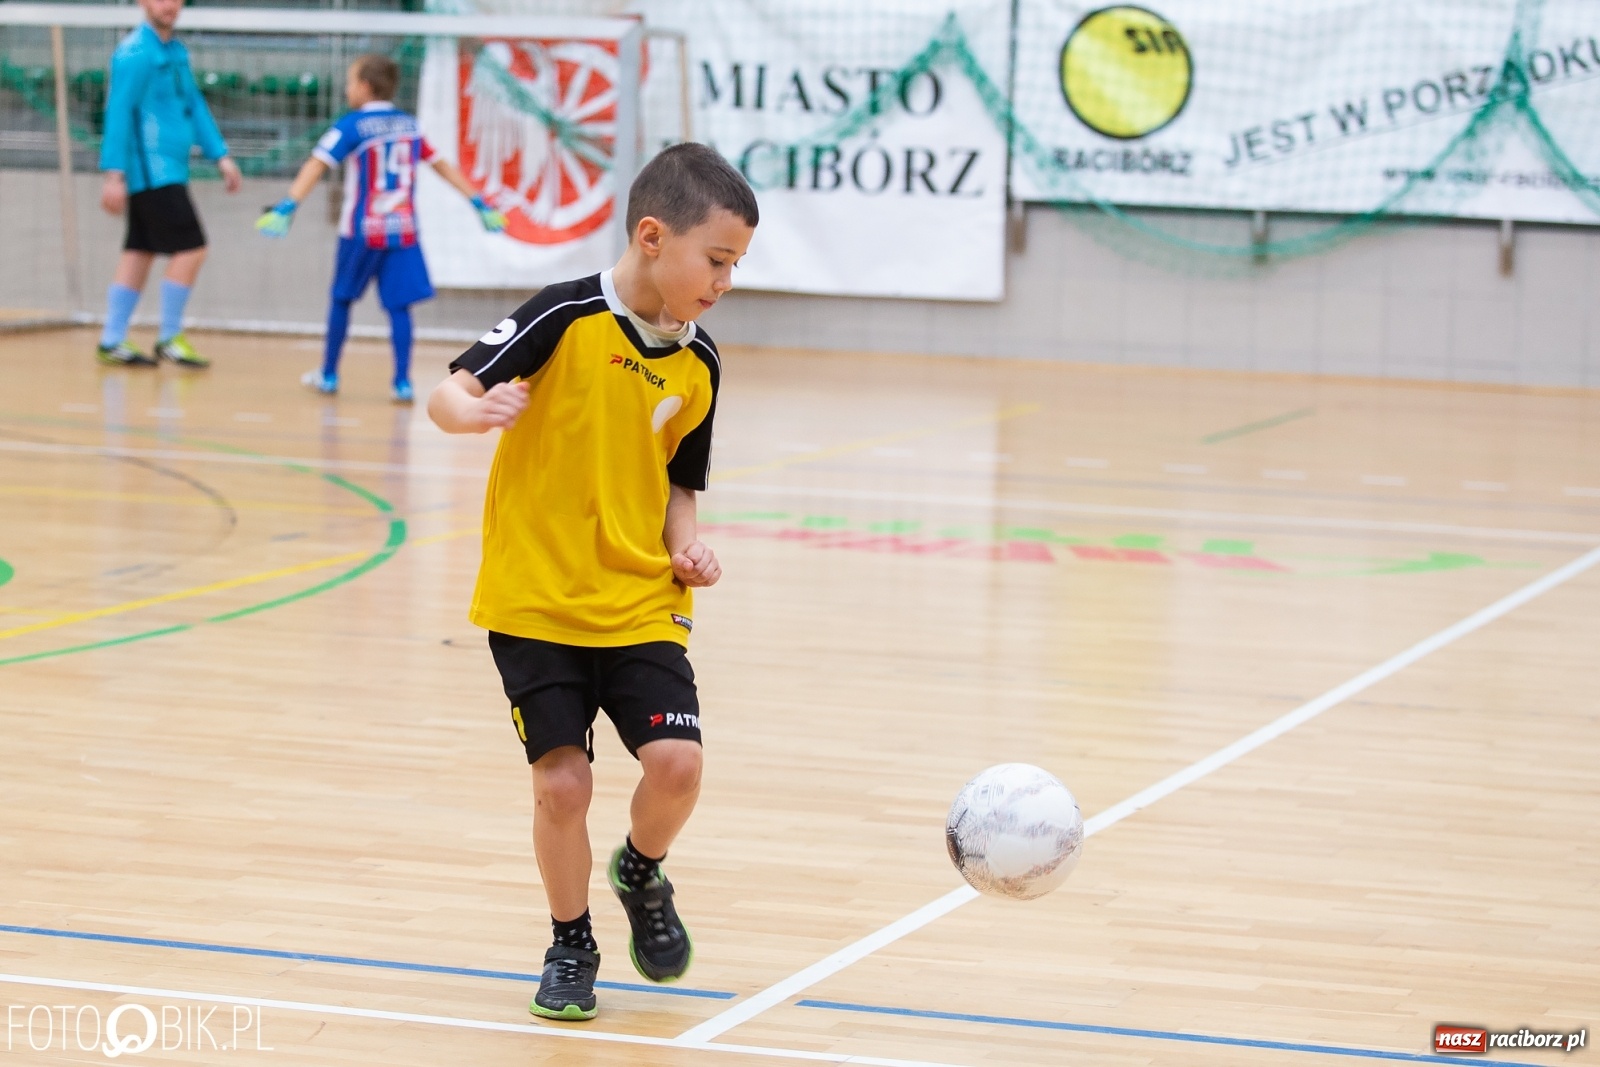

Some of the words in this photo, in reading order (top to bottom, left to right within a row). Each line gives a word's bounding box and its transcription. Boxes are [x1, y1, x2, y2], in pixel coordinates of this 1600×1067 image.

[699, 61, 942, 116] MIASTO
[1222, 112, 1318, 168] JEST
[1329, 96, 1369, 134] W
[661, 134, 985, 197] CIBÓRZ
[623, 357, 667, 391] PATRICK
[512, 706, 528, 742] 1
